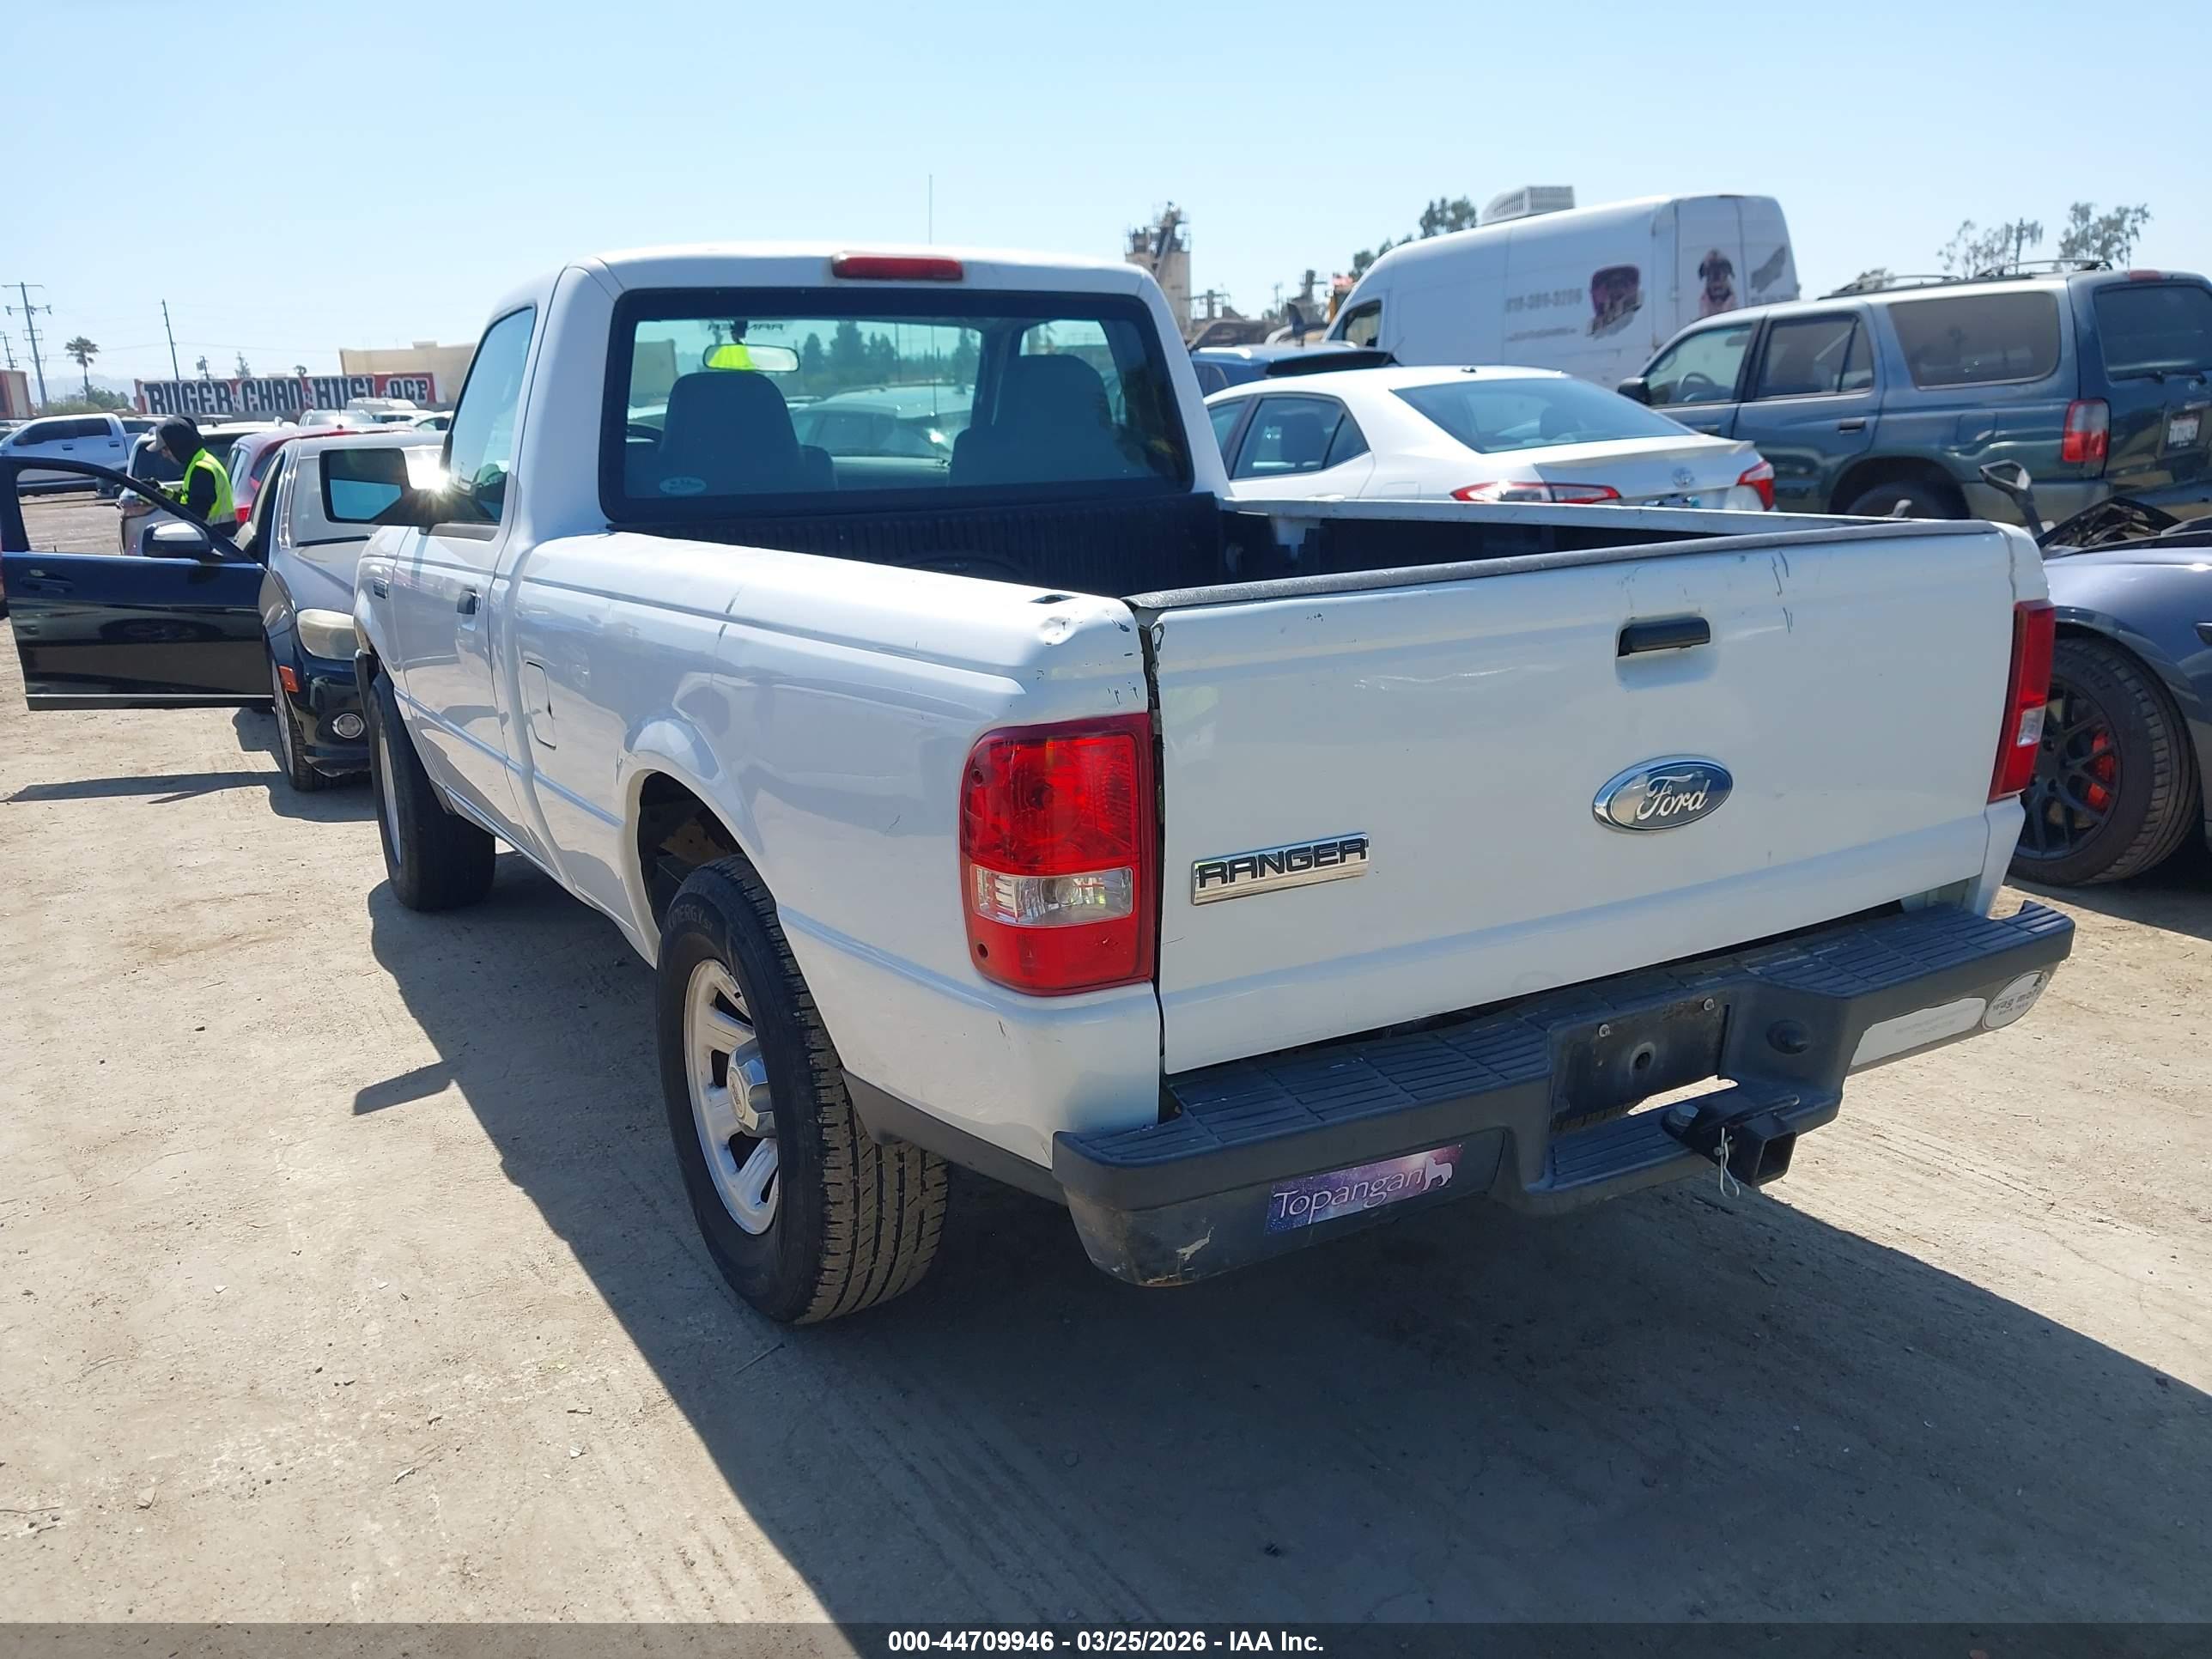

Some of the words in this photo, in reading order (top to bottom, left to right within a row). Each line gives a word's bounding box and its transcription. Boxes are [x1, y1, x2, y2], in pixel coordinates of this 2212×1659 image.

[1636, 773, 1711, 820] Ford
[1197, 837, 1368, 889] RANGER
[1273, 1165, 1426, 1224] Topangan
